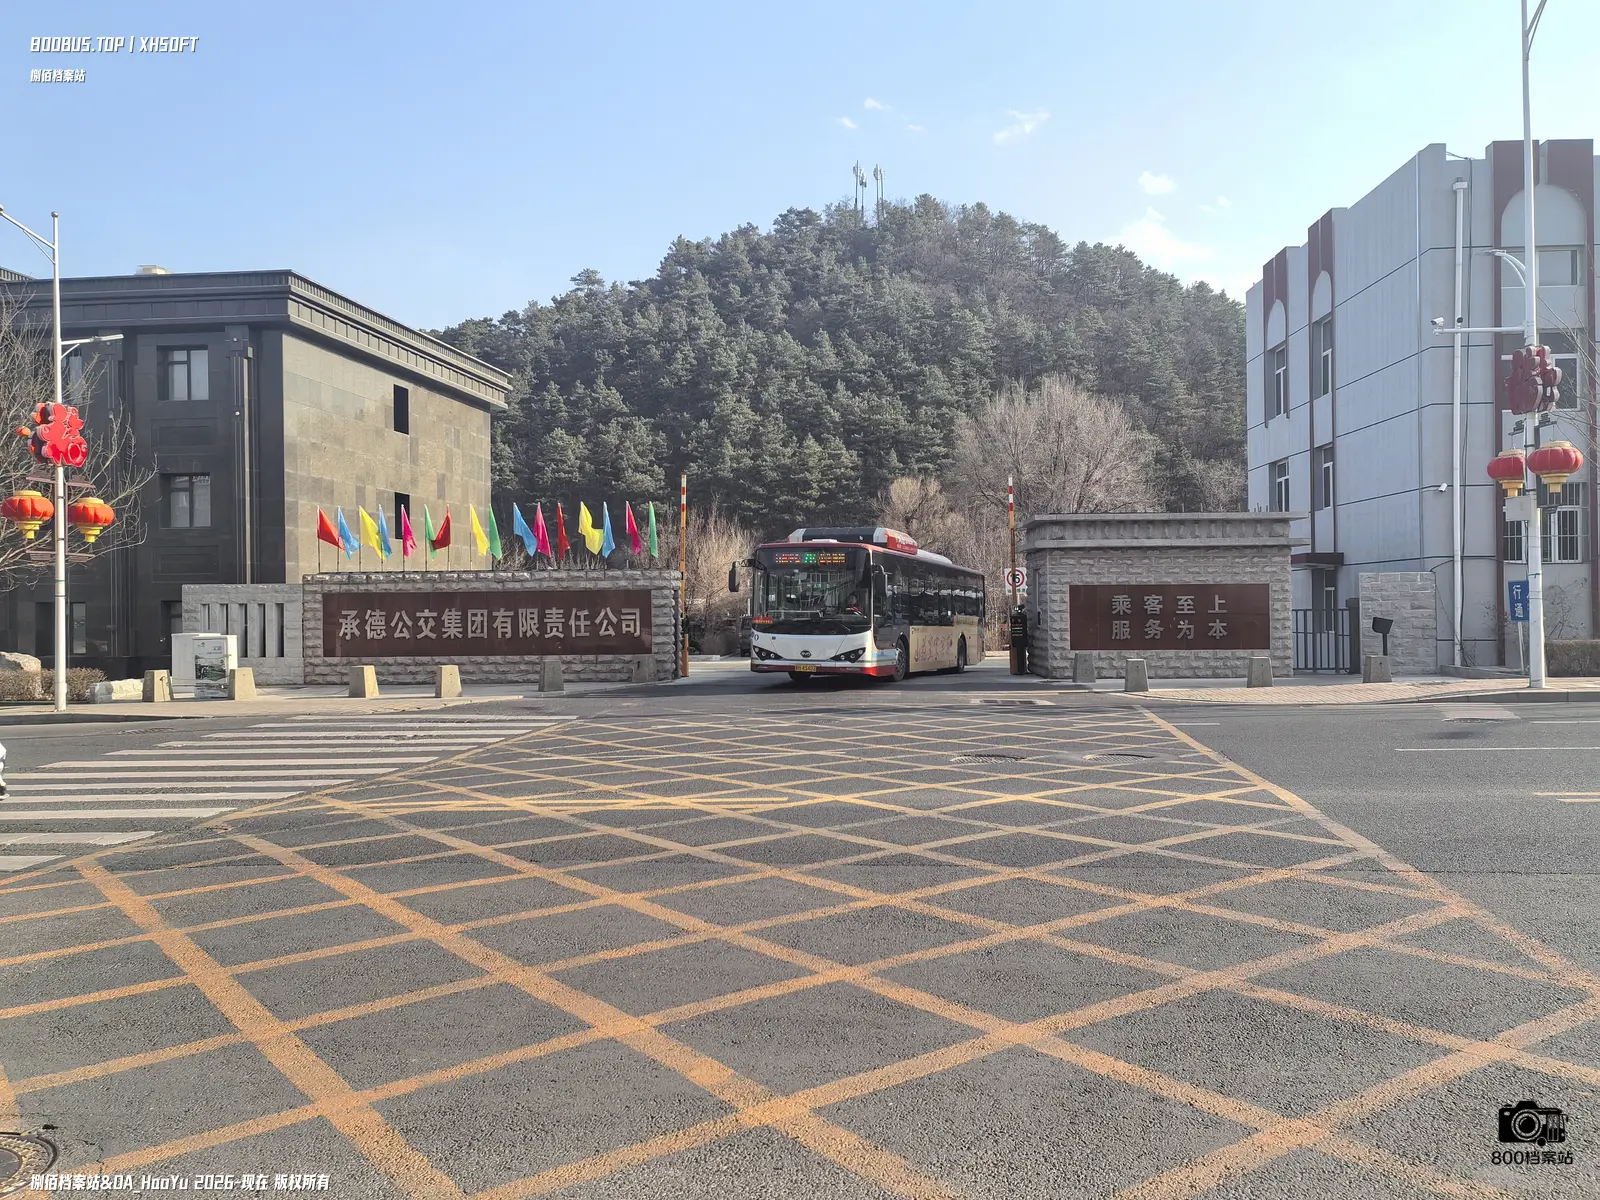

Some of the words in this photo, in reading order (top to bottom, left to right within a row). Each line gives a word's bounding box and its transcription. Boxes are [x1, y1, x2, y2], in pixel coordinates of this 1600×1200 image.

[1111, 594, 1228, 616] 乘客至上
[338, 606, 641, 641] 承德公交集团有限责任公司
[1111, 619, 1228, 640] 服务为本
